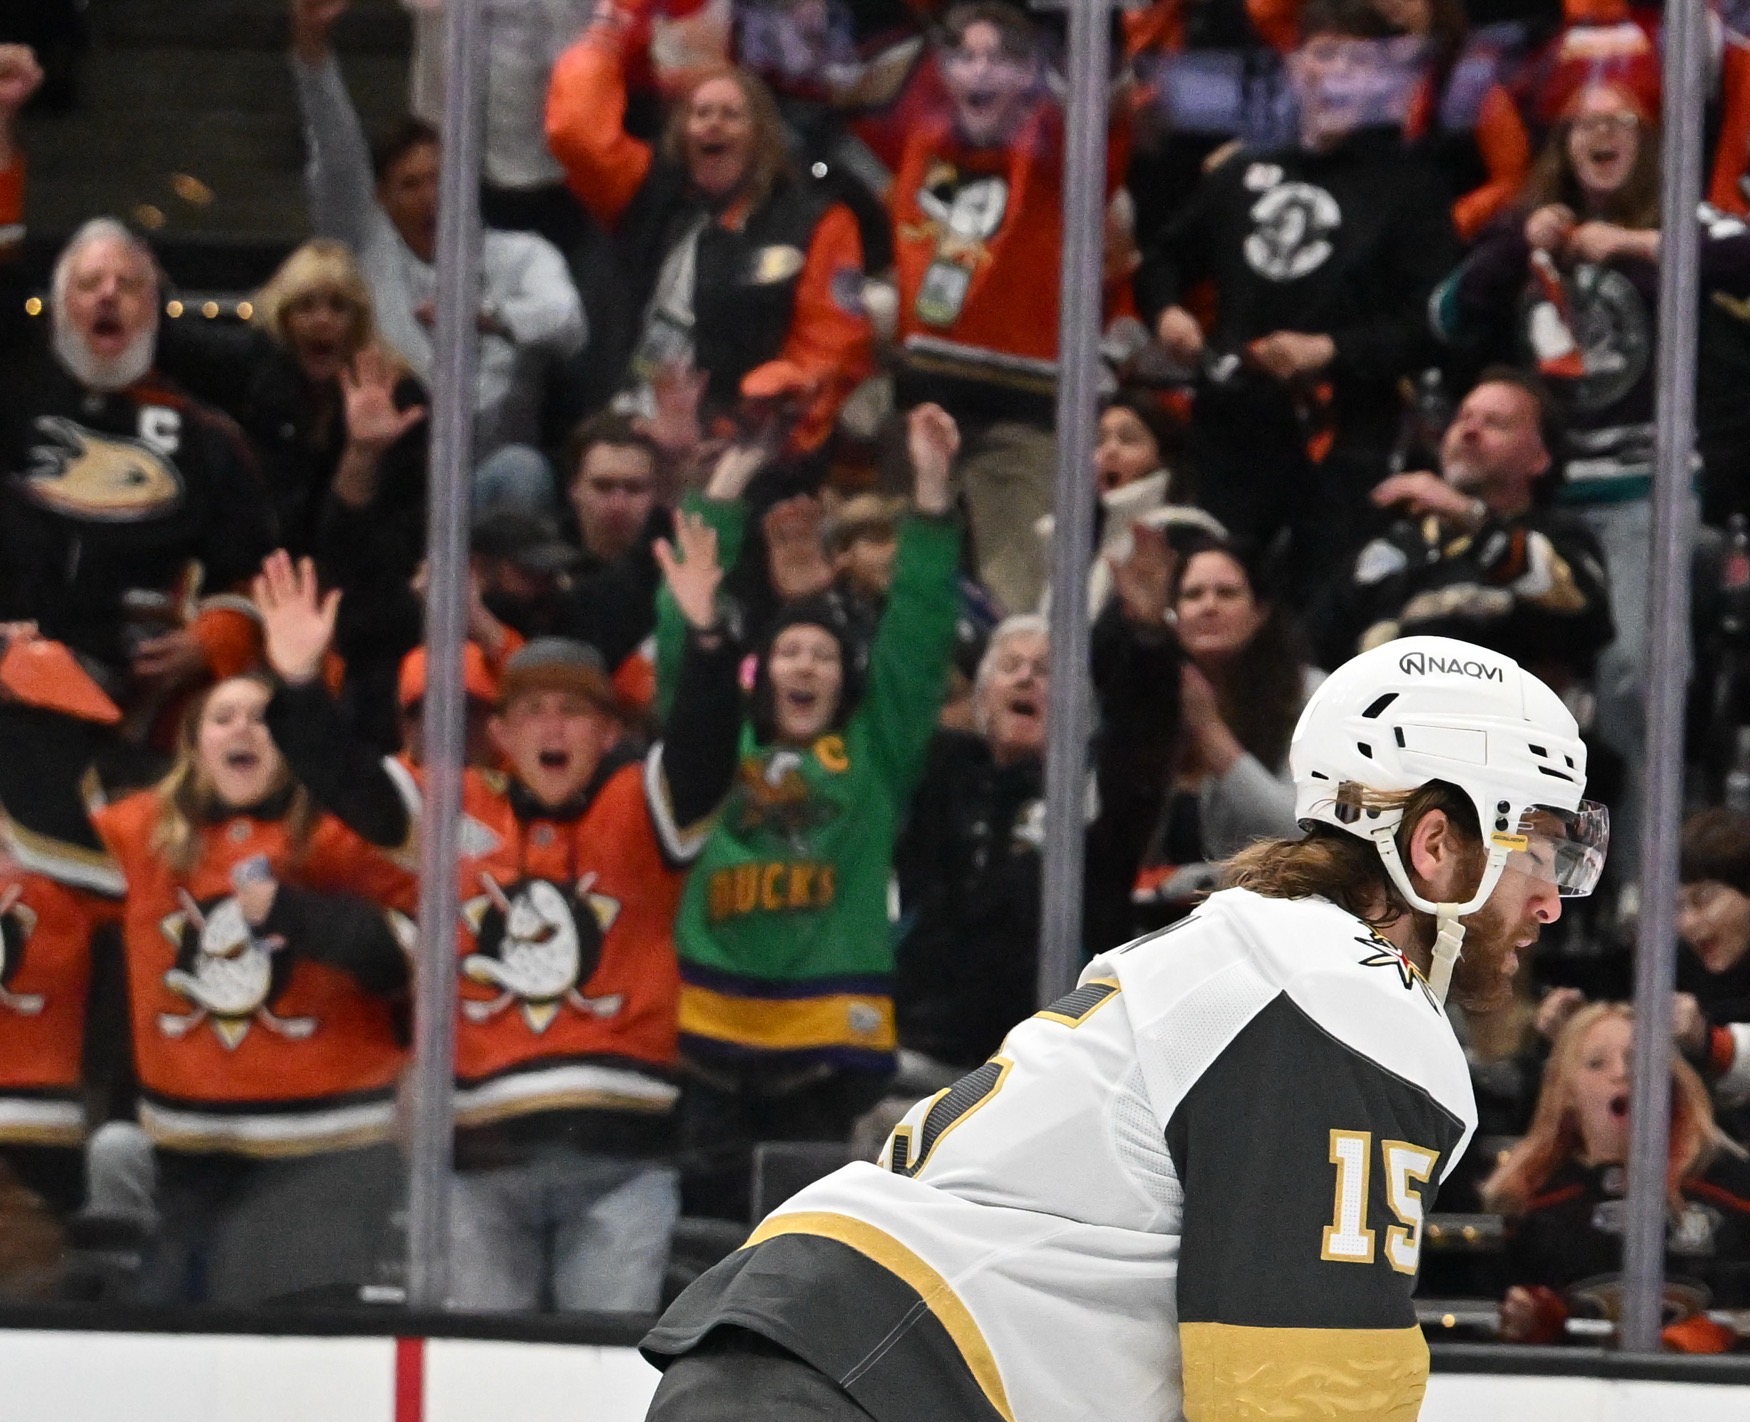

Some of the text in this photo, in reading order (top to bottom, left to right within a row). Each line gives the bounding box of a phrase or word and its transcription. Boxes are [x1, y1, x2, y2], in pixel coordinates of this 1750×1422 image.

[139, 405, 181, 454] C
[1428, 656, 1503, 683] NAQVI
[814, 735, 851, 773] C
[1320, 1128, 1441, 1276] 15
